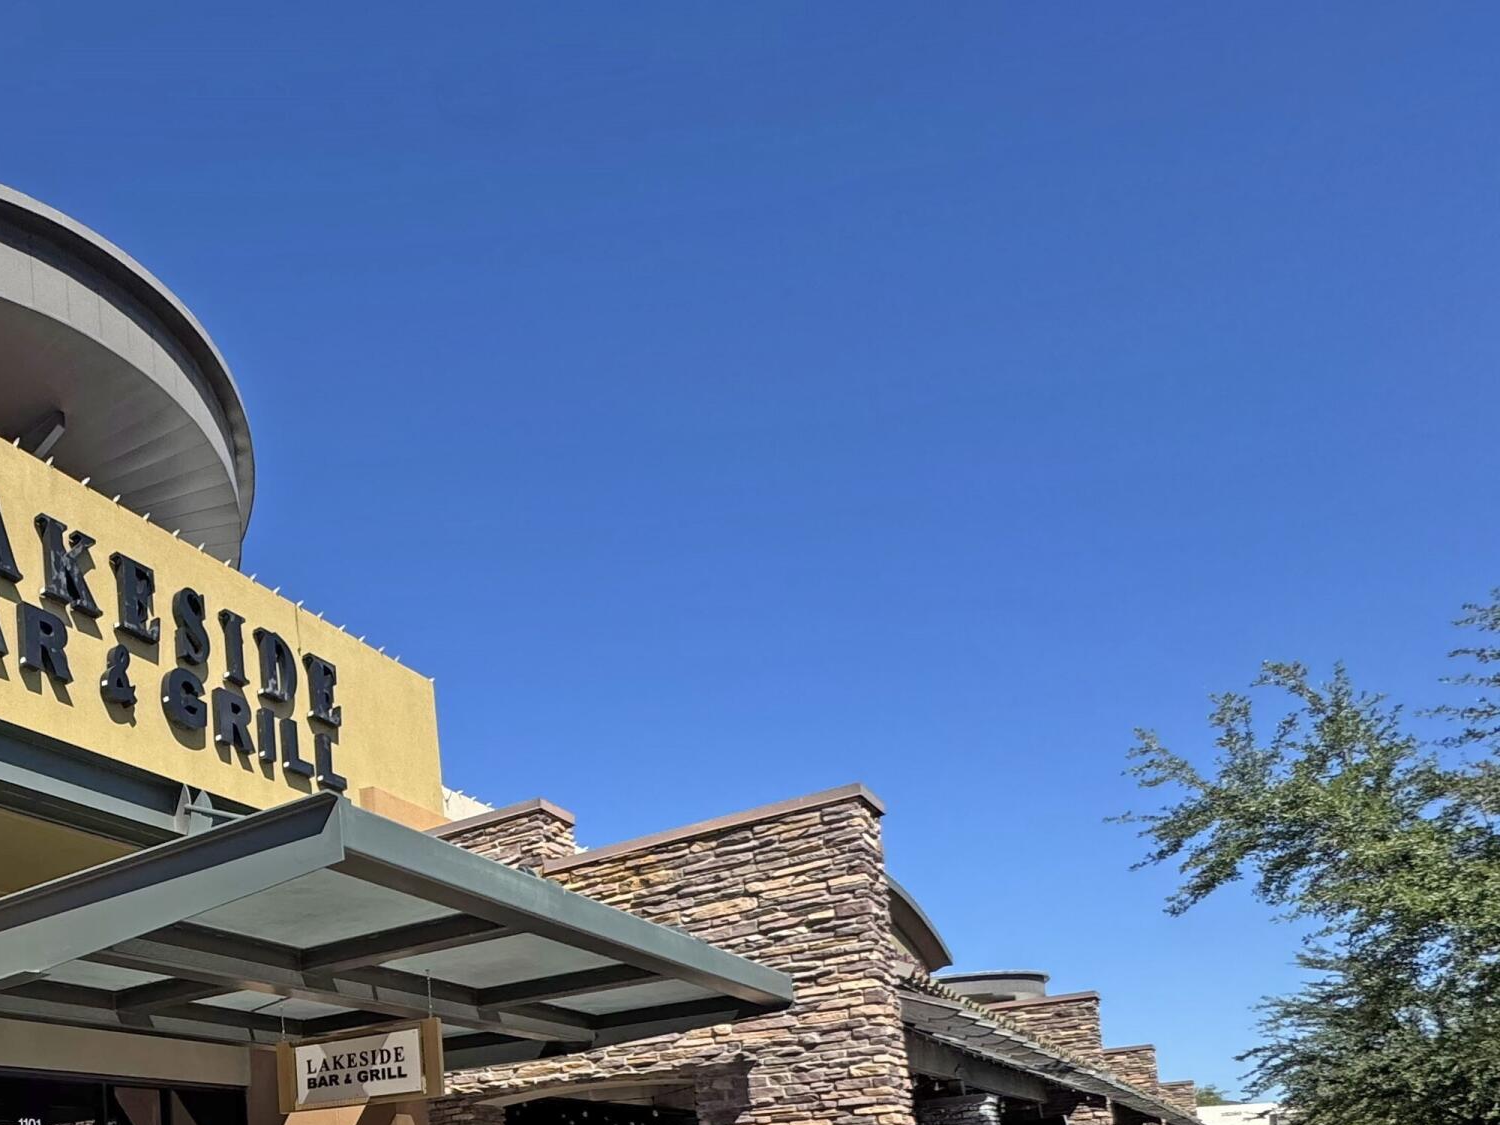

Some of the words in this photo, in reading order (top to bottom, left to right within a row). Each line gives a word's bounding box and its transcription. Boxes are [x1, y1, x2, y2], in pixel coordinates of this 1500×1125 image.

[101, 644, 137, 709] &
[160, 667, 347, 792] GRILL
[306, 1046, 405, 1074] LAKESIDE
[307, 1074, 339, 1089] BAR
[344, 1073, 352, 1085] &
[357, 1066, 407, 1083] GRILL
